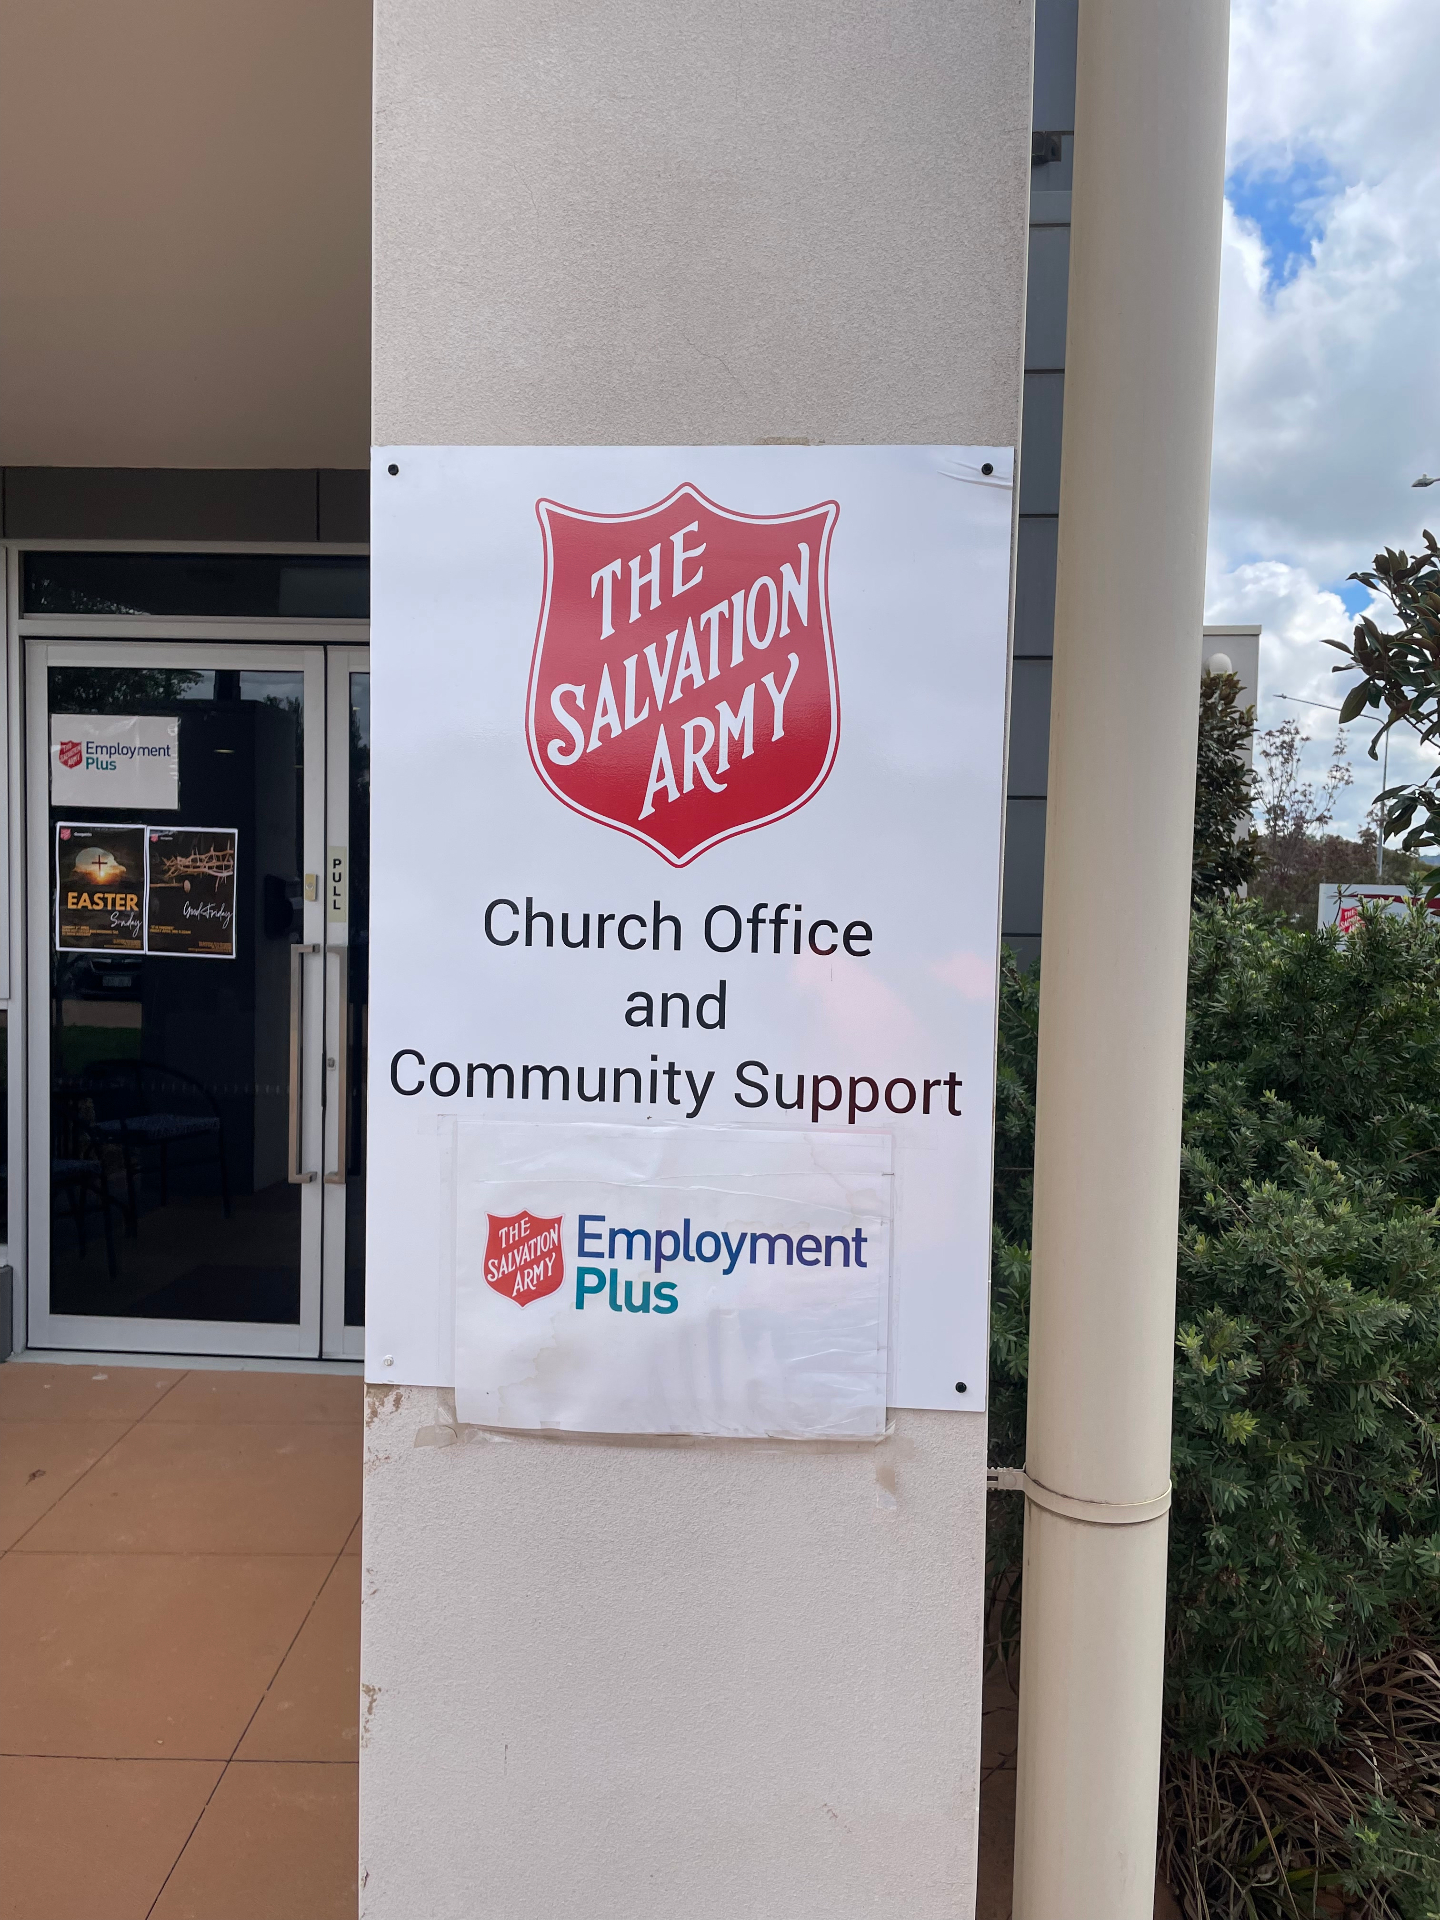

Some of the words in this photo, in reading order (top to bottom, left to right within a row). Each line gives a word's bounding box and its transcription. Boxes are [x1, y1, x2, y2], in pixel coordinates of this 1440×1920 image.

[590, 520, 707, 640] THE
[546, 542, 811, 766] SALVATION
[86, 741, 171, 759] Employment
[637, 652, 800, 821] ARMY
[86, 757, 117, 771] Plus
[67, 891, 139, 911] EASTER
[332, 858, 342, 910] PULL
[484, 896, 682, 951] Church
[704, 902, 874, 957] Office
[624, 979, 727, 1030] and
[390, 1048, 716, 1119] Community
[734, 1060, 963, 1125] Support
[487, 1223, 559, 1282] SALVATION
[498, 1217, 531, 1249] THE
[577, 1214, 868, 1275] Employment
[511, 1252, 556, 1298] ARMY
[575, 1266, 679, 1315] Plus
